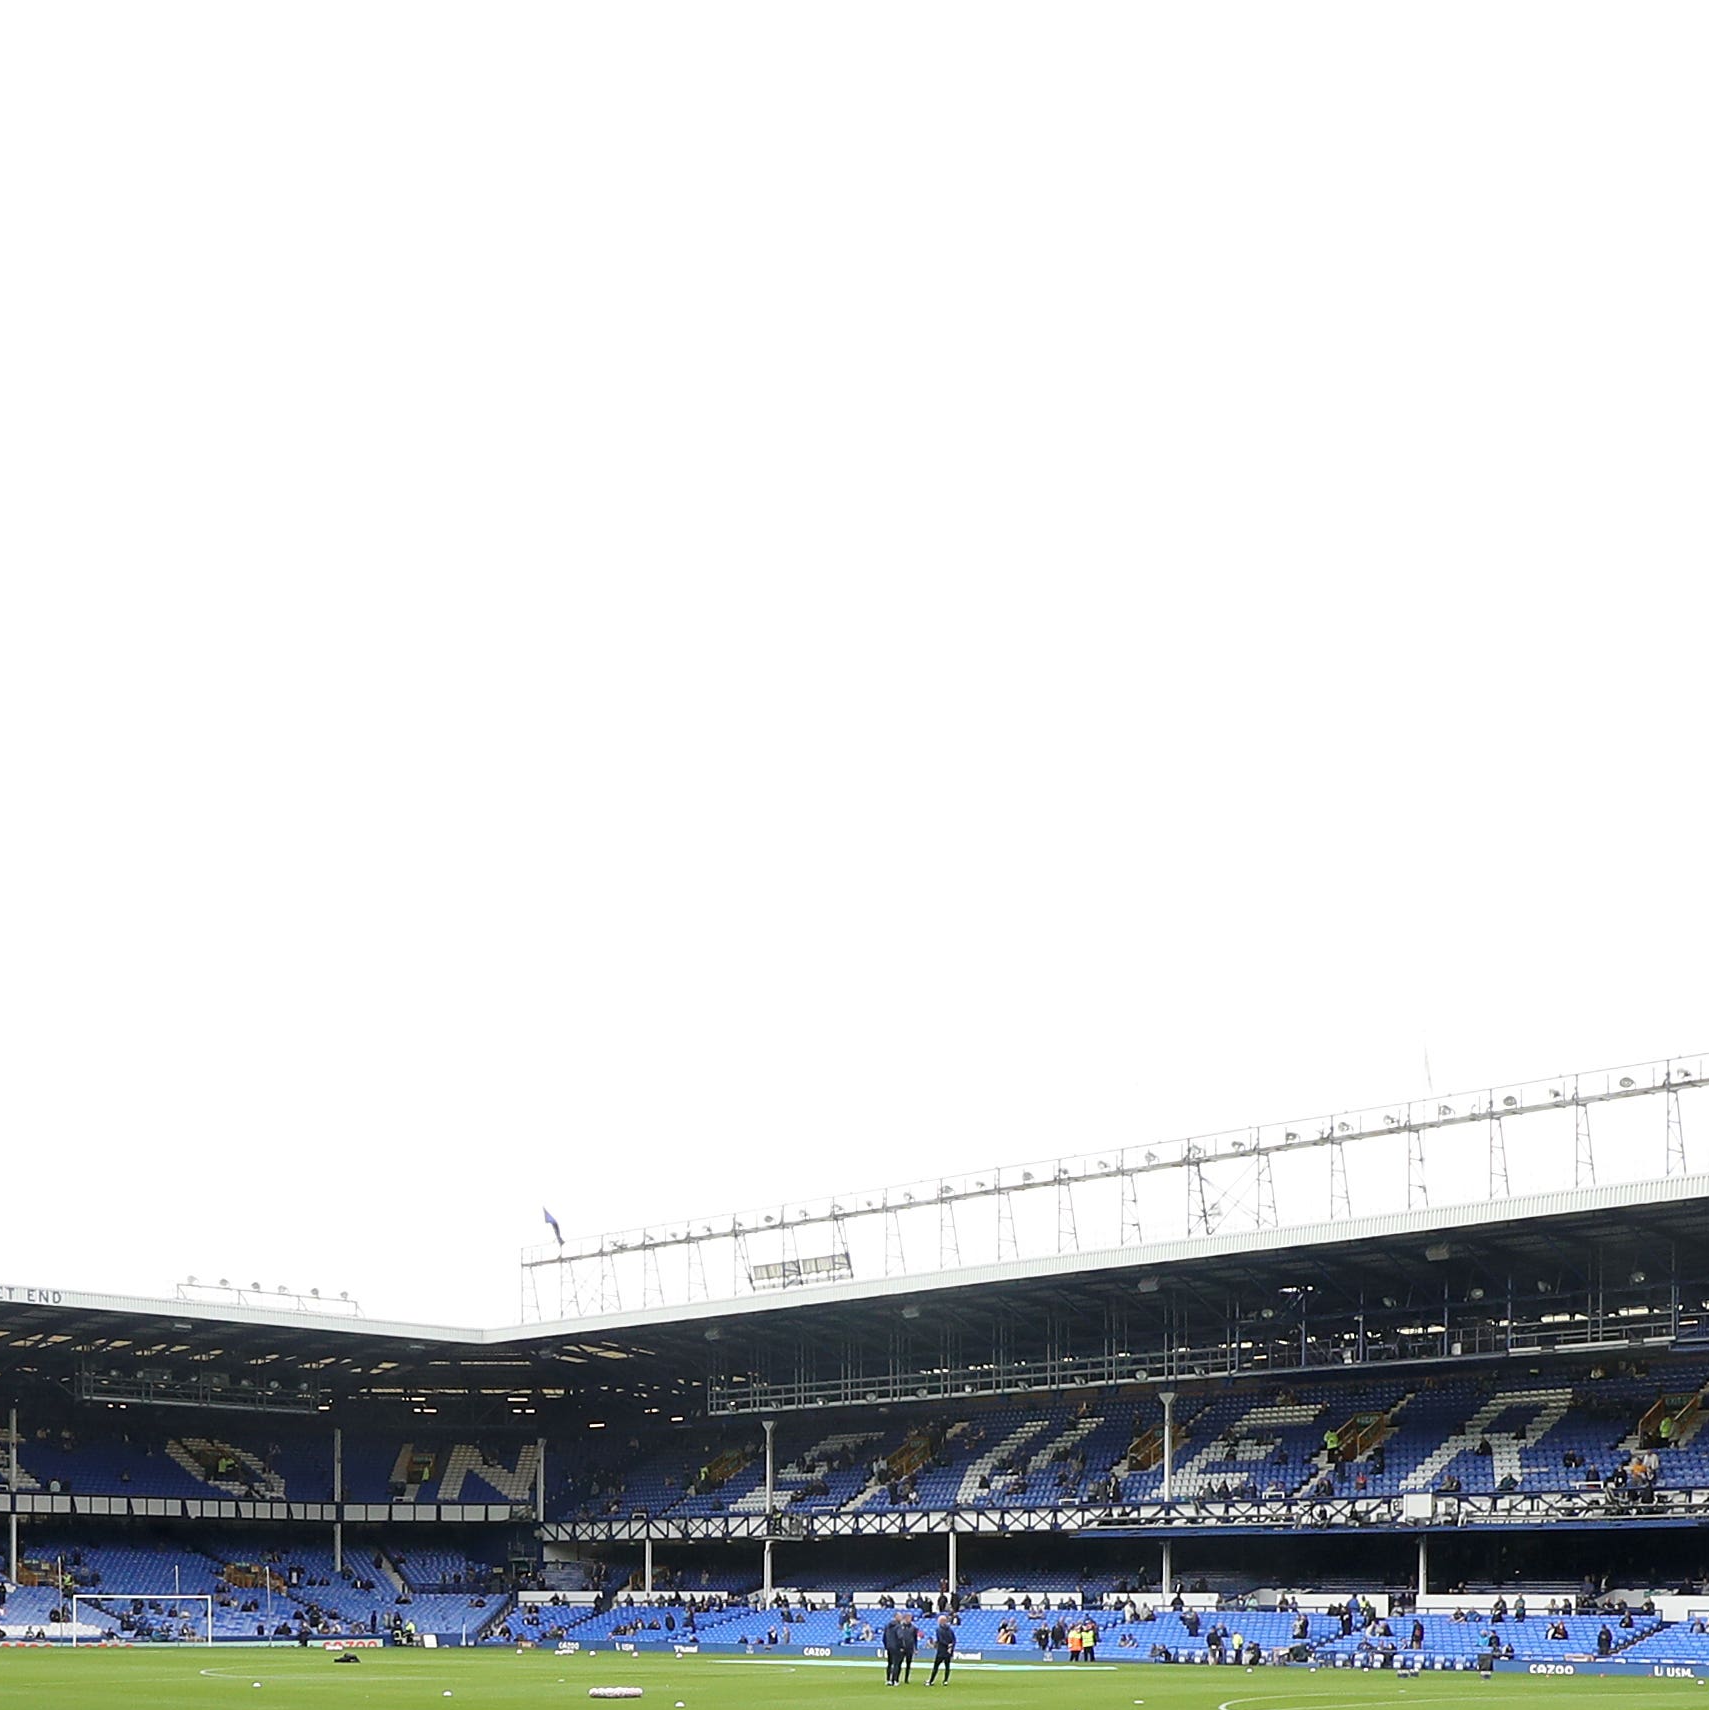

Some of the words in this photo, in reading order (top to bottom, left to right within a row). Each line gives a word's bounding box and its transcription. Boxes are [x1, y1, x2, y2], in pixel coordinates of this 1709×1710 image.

[27, 1290, 62, 1304] END
[803, 1646, 832, 1657] CAZOO
[1529, 1663, 1575, 1676] CAZOO
